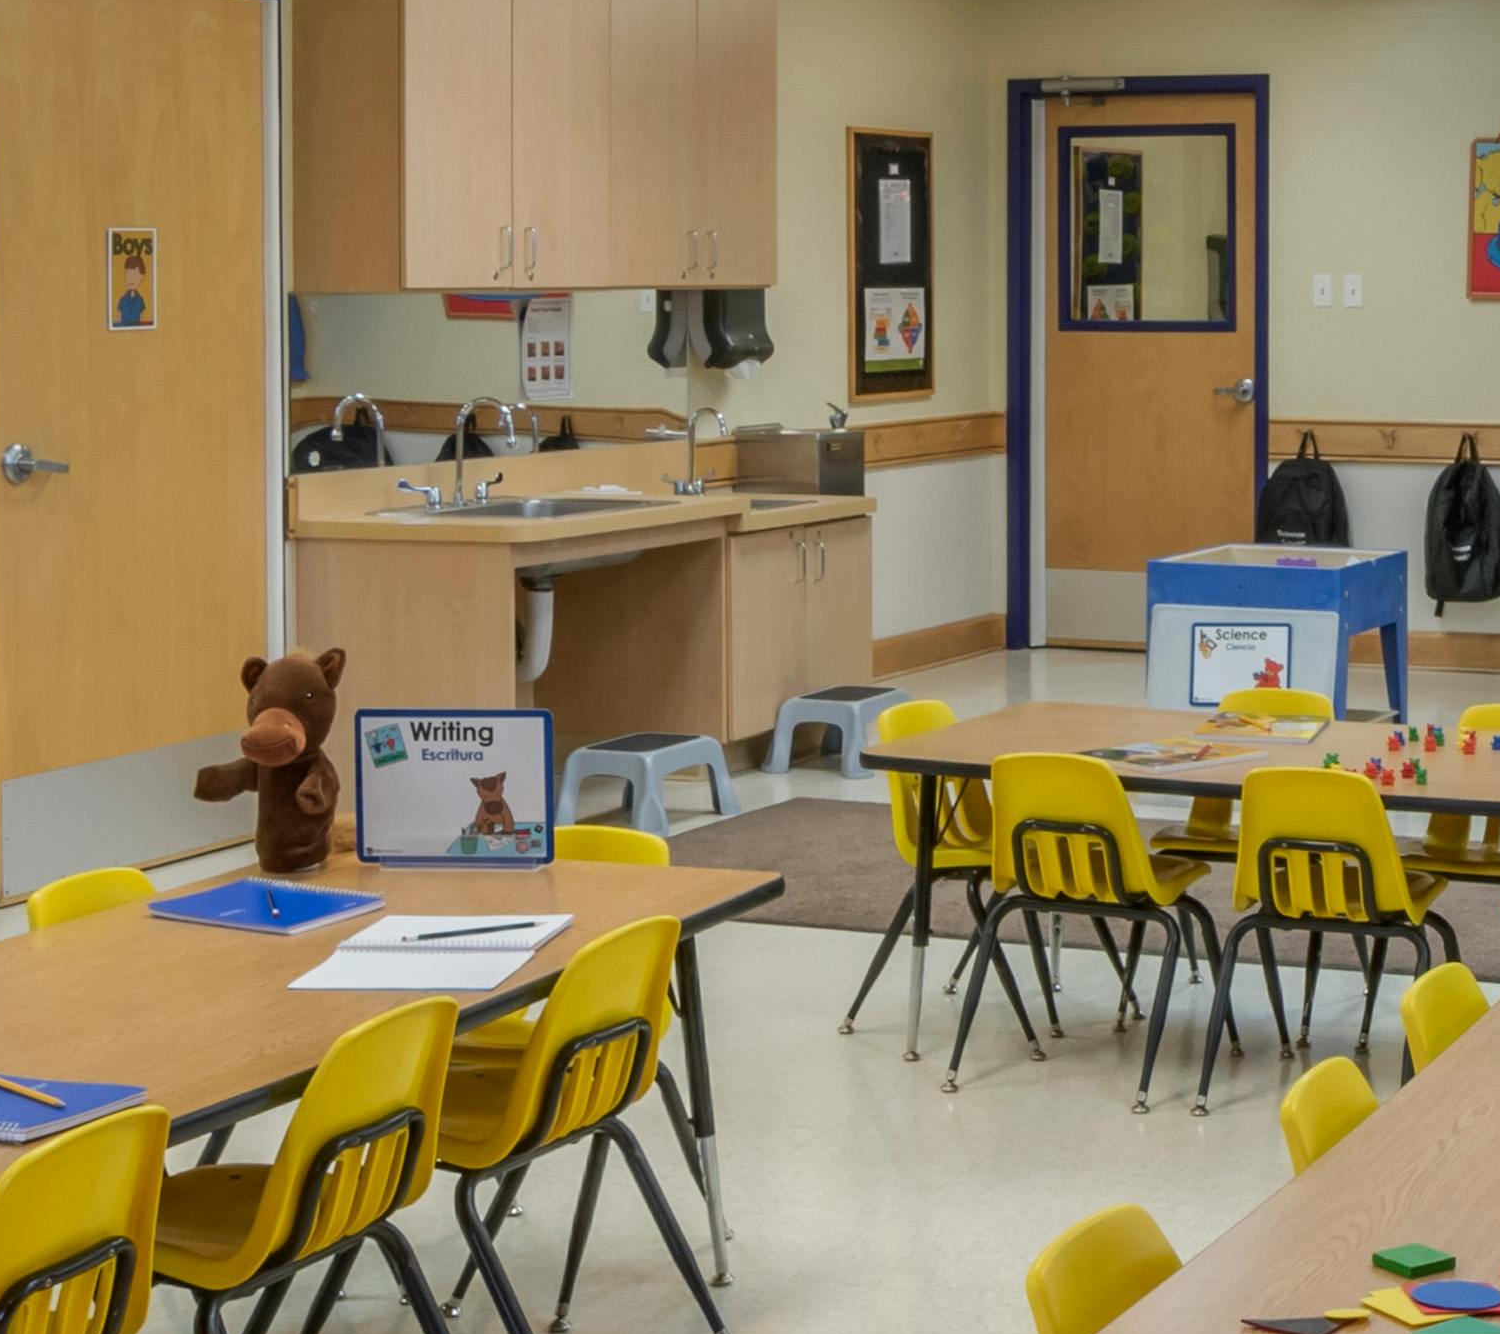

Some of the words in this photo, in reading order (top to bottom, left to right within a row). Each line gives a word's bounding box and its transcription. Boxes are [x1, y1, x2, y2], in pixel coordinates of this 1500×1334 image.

[112, 233, 153, 259] Boys
[1215, 628, 1268, 641] Science
[1225, 643, 1257, 651] Ciencia
[410, 721, 494, 747] Writing
[421, 748, 484, 762] Escritura
